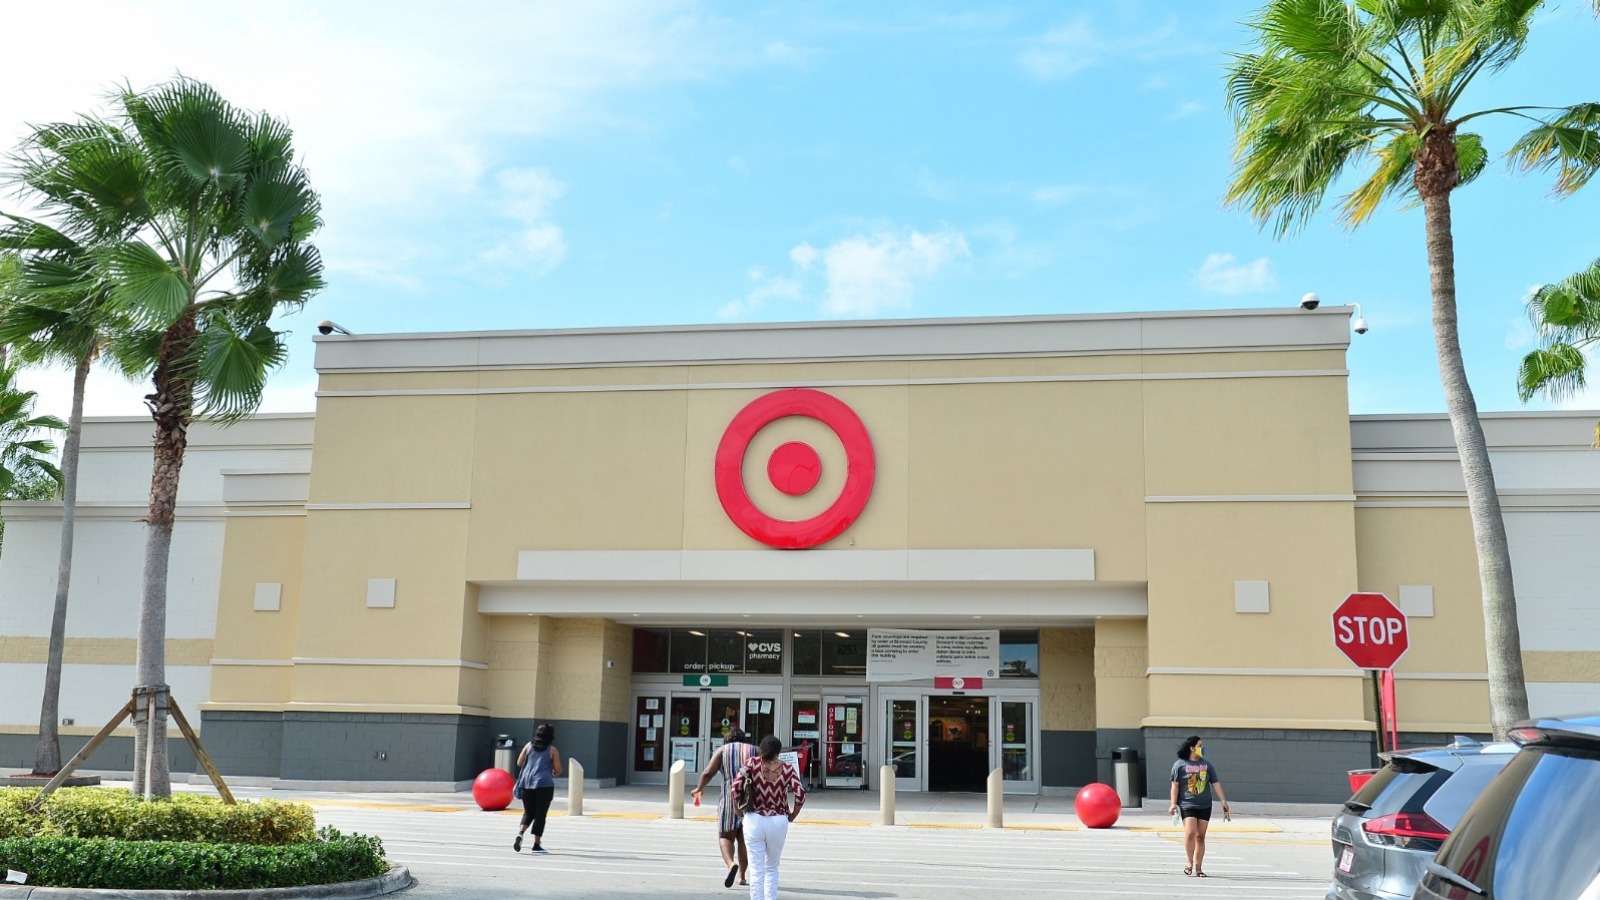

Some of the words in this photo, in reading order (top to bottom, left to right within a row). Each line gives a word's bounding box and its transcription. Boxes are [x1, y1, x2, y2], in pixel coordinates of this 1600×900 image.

[1338, 616, 1402, 644] STOP
[759, 643, 781, 652] CVS
[708, 662, 734, 670] pickup
